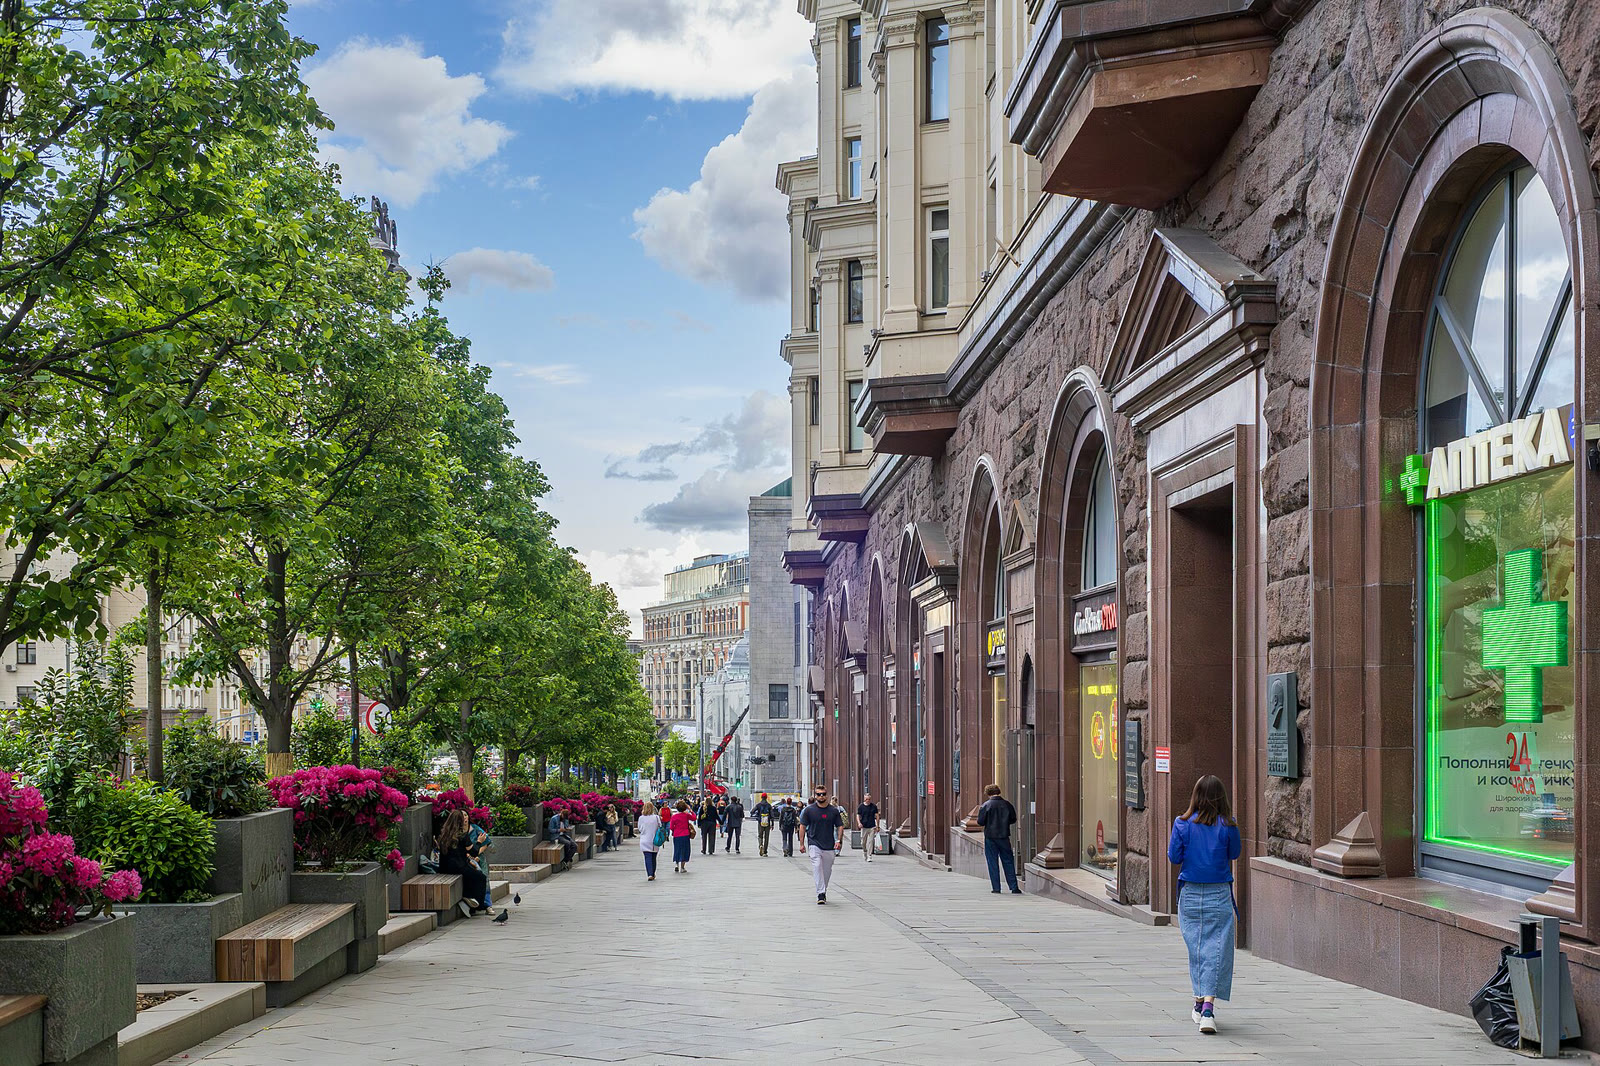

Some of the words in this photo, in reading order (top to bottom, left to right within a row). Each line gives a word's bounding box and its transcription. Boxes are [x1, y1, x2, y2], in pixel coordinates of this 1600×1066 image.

[1426, 407, 1570, 500] АПТЕКА
[374, 710, 392, 726] 50
[1506, 732, 1532, 772] 24
[1477, 776, 1486, 786] и
[1512, 775, 1537, 796] часа
[1495, 794, 1531, 803] Широкий
[1489, 805, 1504, 813] для
